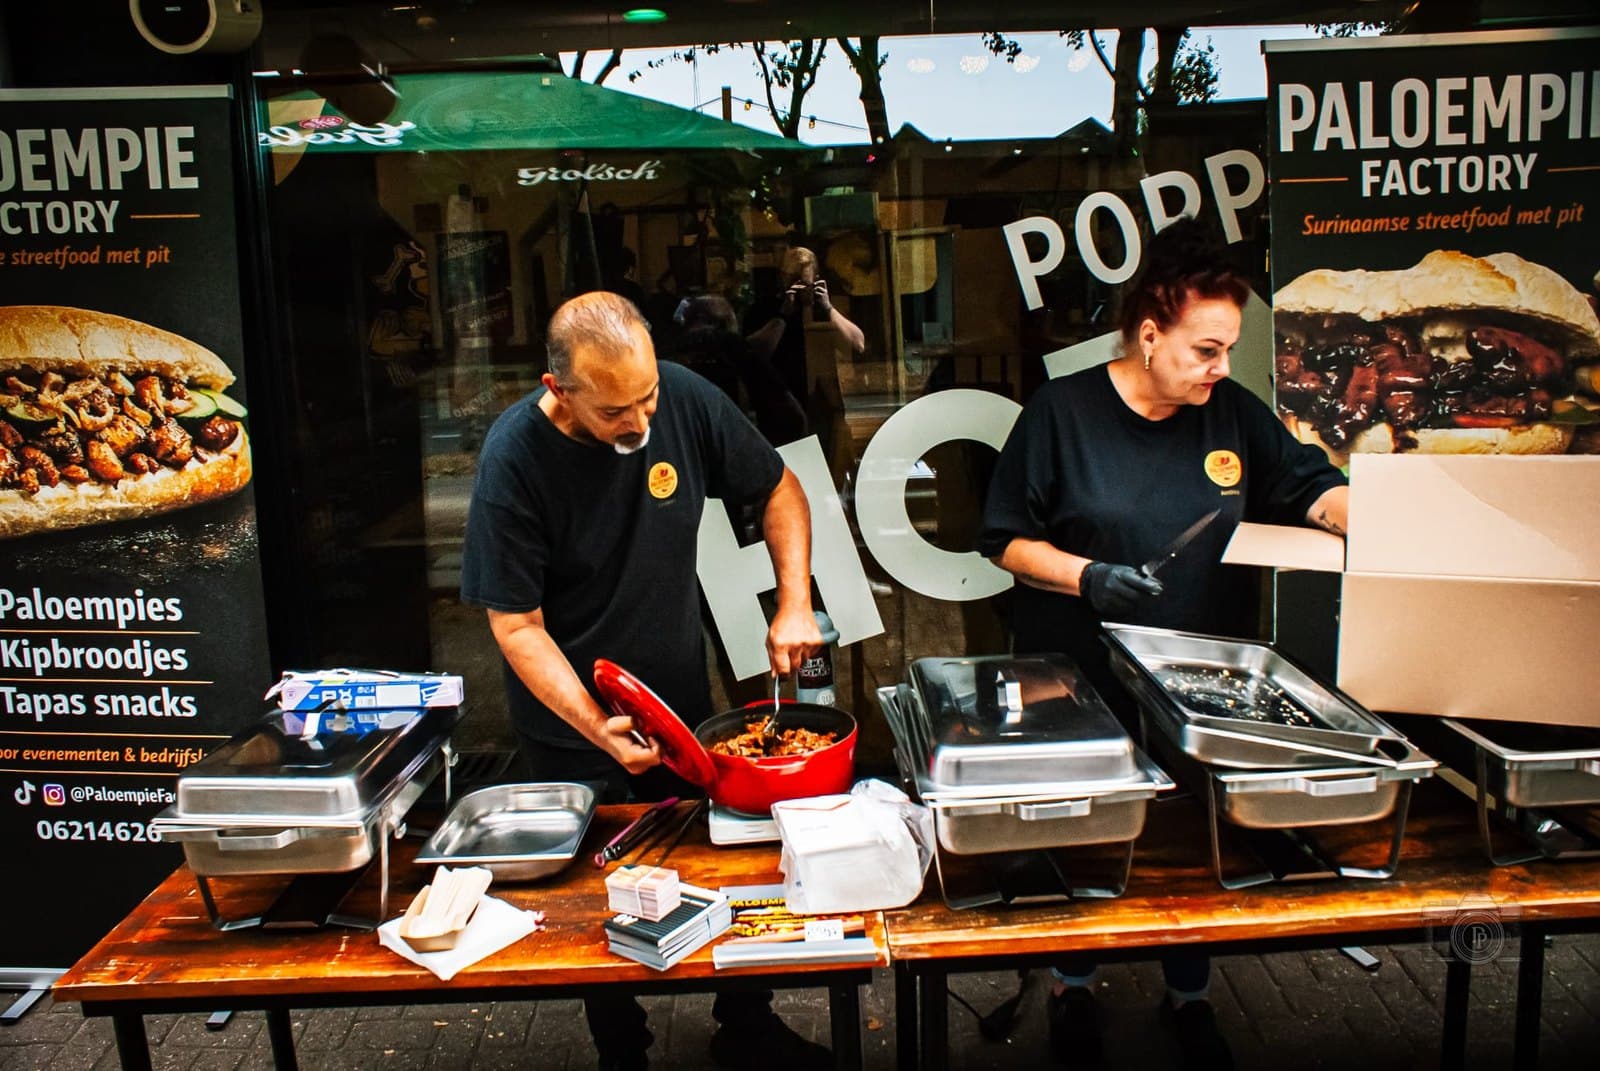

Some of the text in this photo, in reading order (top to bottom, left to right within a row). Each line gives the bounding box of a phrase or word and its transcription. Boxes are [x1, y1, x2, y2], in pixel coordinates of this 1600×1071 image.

[1361, 153, 1538, 197] FACTORY
[0, 200, 120, 235] CTORY
[1302, 202, 1584, 236] Surinaamse streetfood met pit
[11, 244, 100, 270] streetfood
[106, 247, 140, 264] met
[145, 245, 171, 269] pit
[0, 587, 183, 629] Paloempies
[0, 638, 189, 677] Kipbroodjes
[0, 686, 198, 722] Tapas snacks
[22, 747, 120, 762] evenementen
[124, 747, 136, 762] &
[140, 747, 208, 768] bedrijfsl
[36, 819, 163, 842] 06214626
